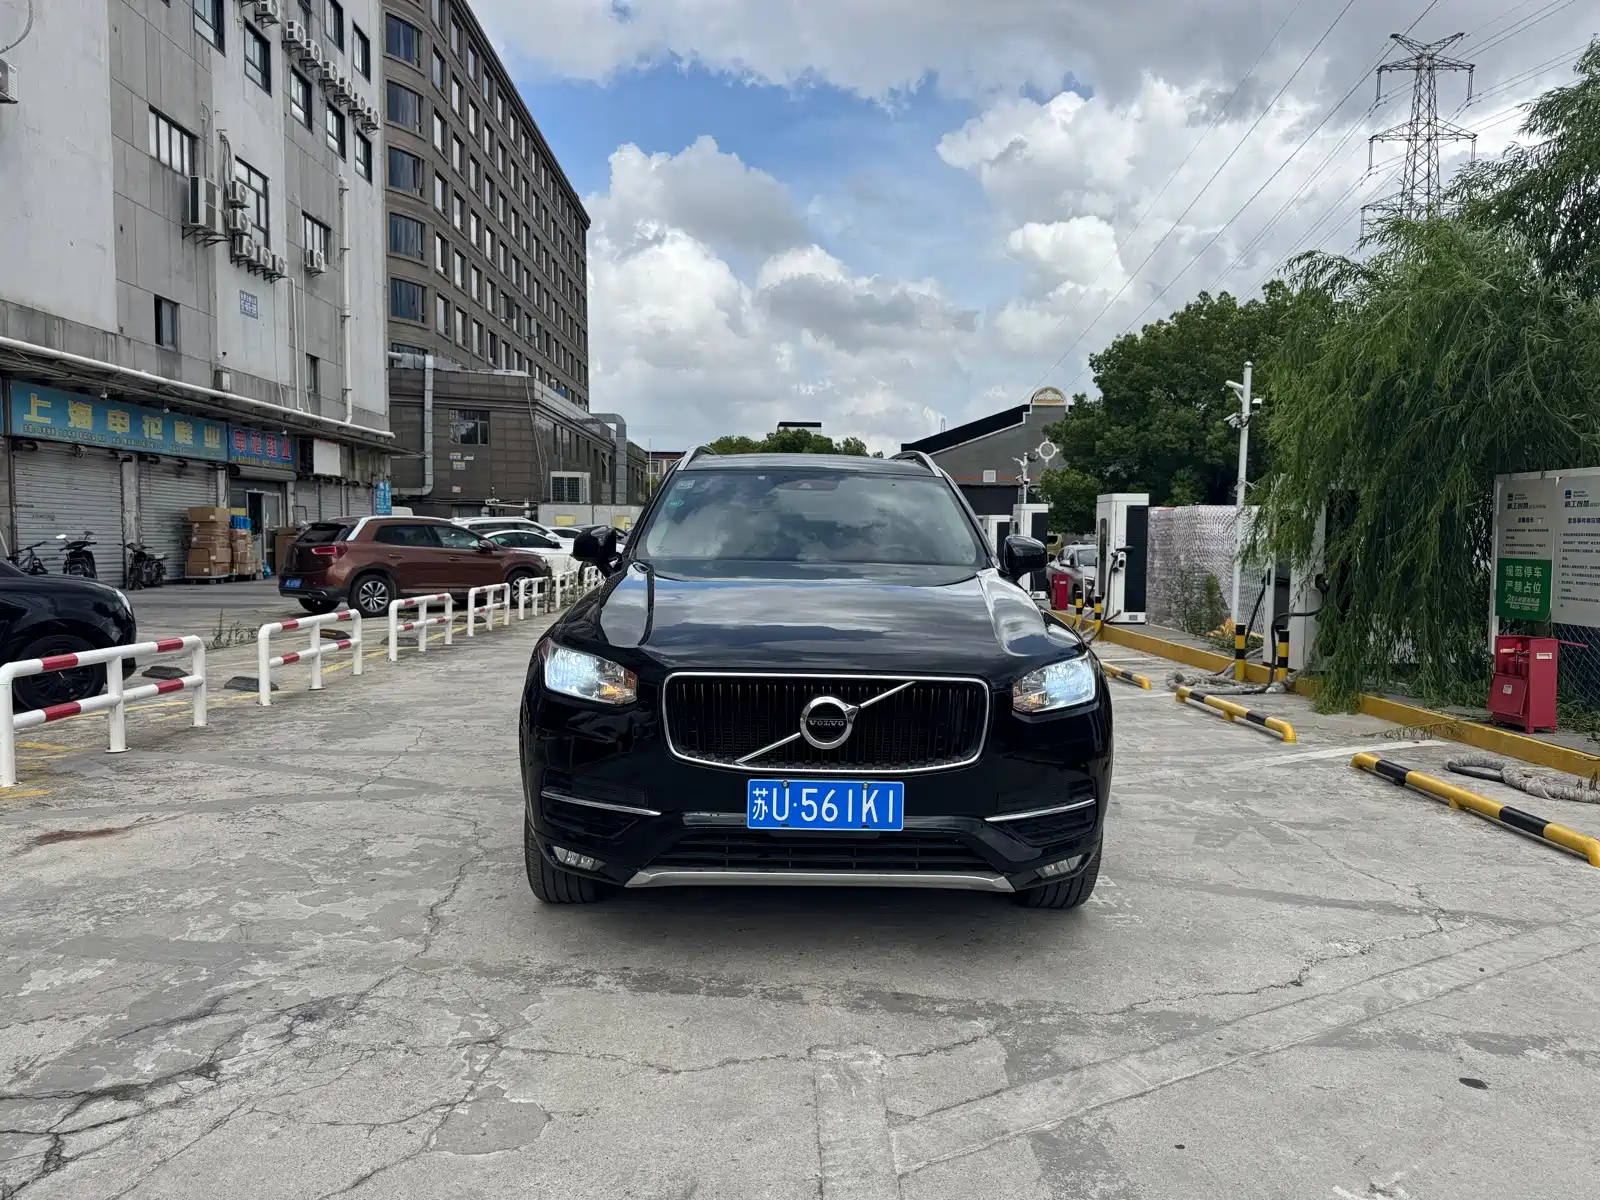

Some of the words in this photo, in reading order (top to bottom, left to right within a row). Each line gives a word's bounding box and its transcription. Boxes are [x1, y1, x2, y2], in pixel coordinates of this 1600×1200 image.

[1505, 565, 1542, 578] 规范停车
[1505, 580, 1541, 594] 严禁占位
[808, 719, 845, 727] VOLVO
